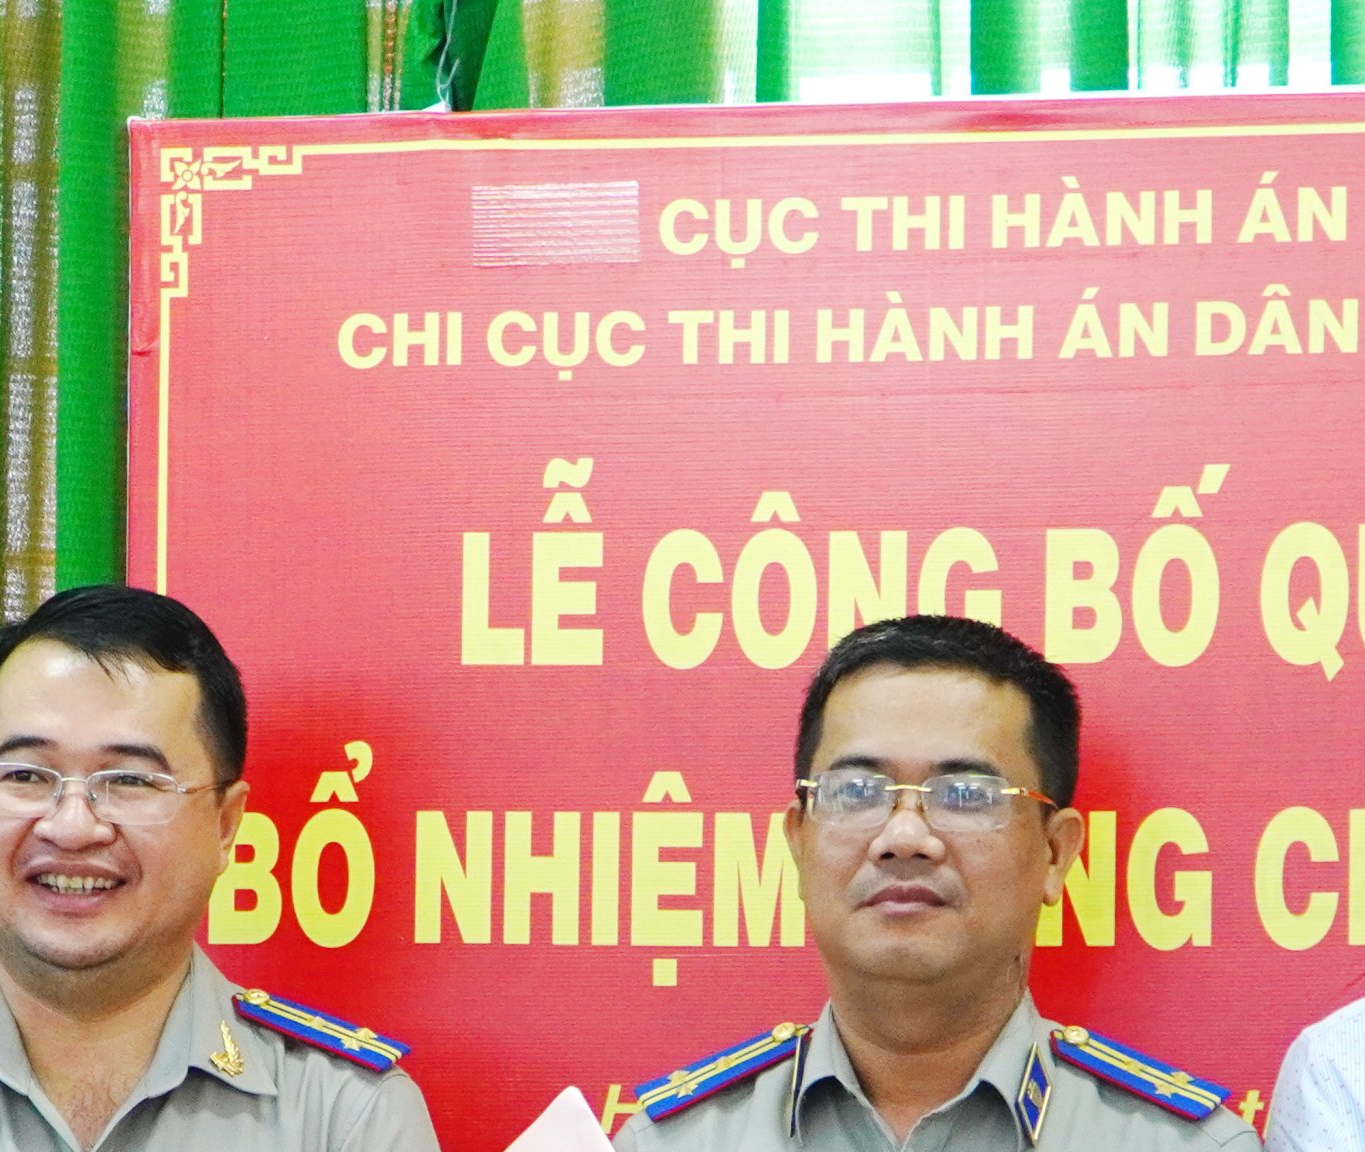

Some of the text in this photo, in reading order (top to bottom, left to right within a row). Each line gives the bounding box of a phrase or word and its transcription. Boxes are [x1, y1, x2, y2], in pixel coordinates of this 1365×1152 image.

[660, 198, 816, 267] CỤC
[843, 196, 963, 249] THI
[993, 177, 1211, 247] HÀNH
[1239, 172, 1347, 242] ÁN
[338, 312, 461, 368] CHI
[487, 311, 644, 380] CỤC
[668, 310, 788, 362] THI
[817, 292, 1032, 362] HÀNH
[1060, 288, 1168, 357] ÁN
[1196, 284, 1358, 355] DÂN
[462, 458, 603, 665] LỄ
[643, 491, 1002, 668] CÔNG
[1045, 464, 1229, 666] BỐ
[209, 741, 374, 947] BỔ
[415, 772, 805, 986] NHIỆM
